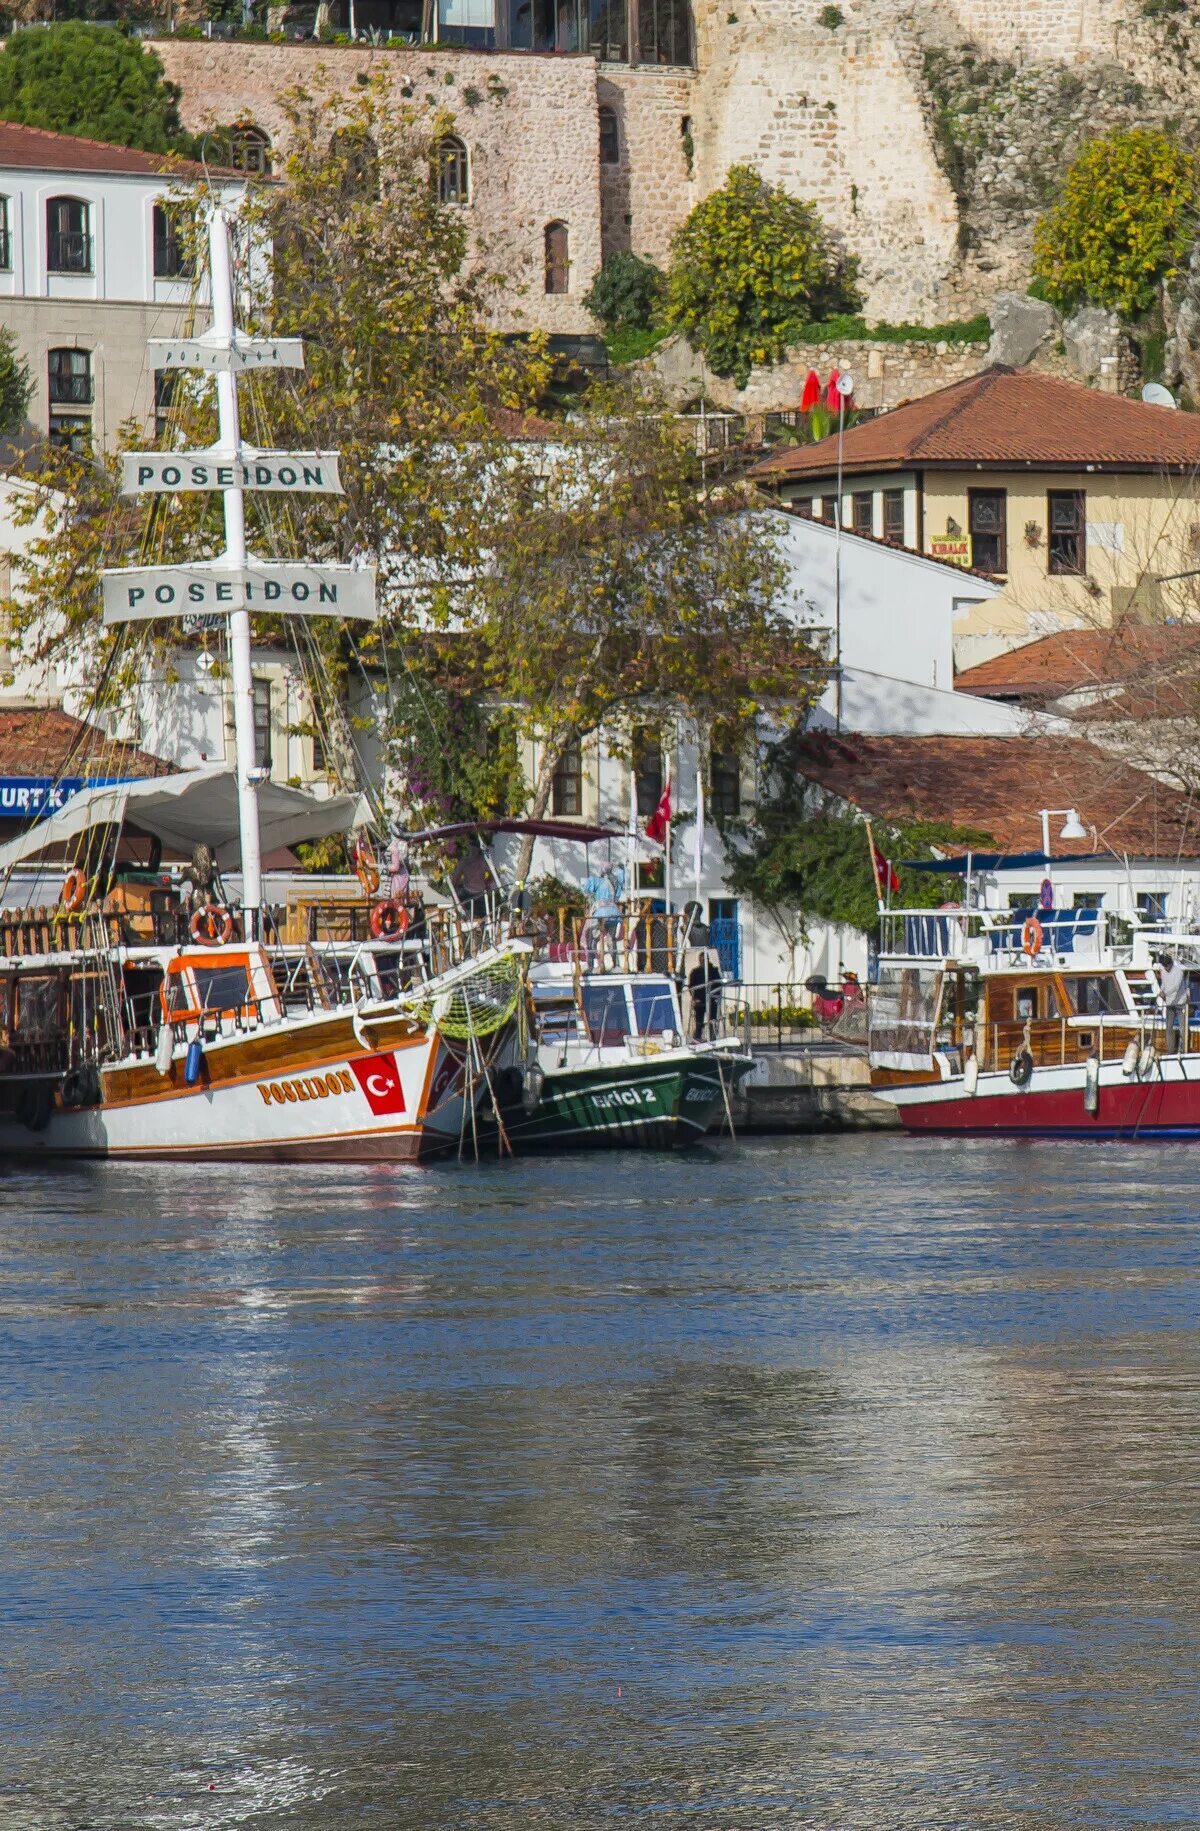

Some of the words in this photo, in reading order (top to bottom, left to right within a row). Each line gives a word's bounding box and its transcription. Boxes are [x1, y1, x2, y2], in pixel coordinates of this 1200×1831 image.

[137, 465, 324, 486] POSEIDON
[127, 581, 338, 607] POSEIDON
[0, 787, 44, 808] URT
[256, 1069, 356, 1106] POSEIDON
[641, 1087, 657, 1103] 2
